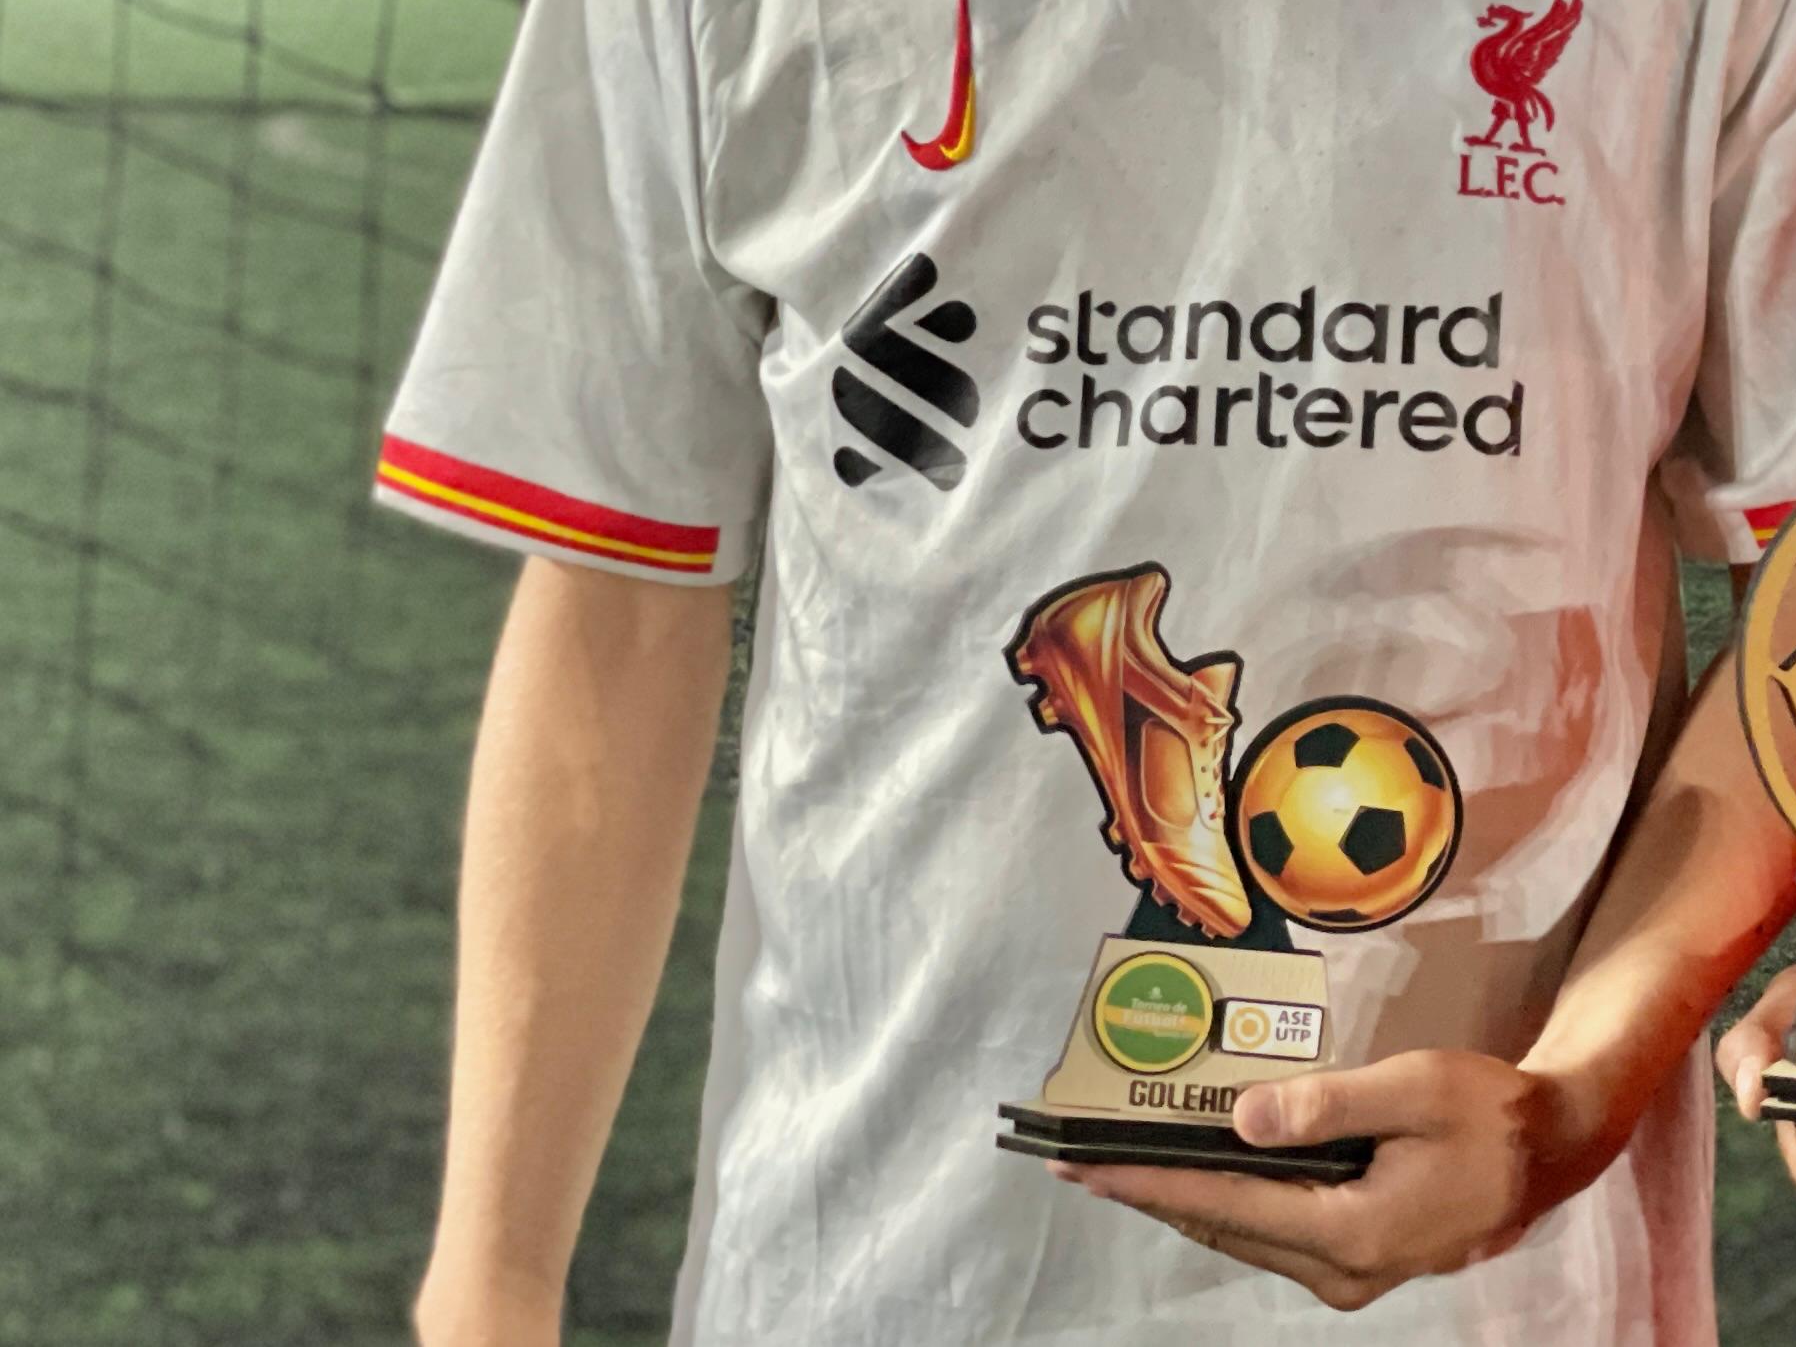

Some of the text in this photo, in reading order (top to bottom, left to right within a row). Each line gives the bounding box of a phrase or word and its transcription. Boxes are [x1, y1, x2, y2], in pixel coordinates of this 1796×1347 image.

[1026, 287, 1503, 369] standard
[1016, 371, 1524, 457] chartered
[1275, 1026, 1312, 1042] UTP
[1278, 1010, 1312, 1027] ASE
[1129, 1079, 1244, 1114] GOLEAD
